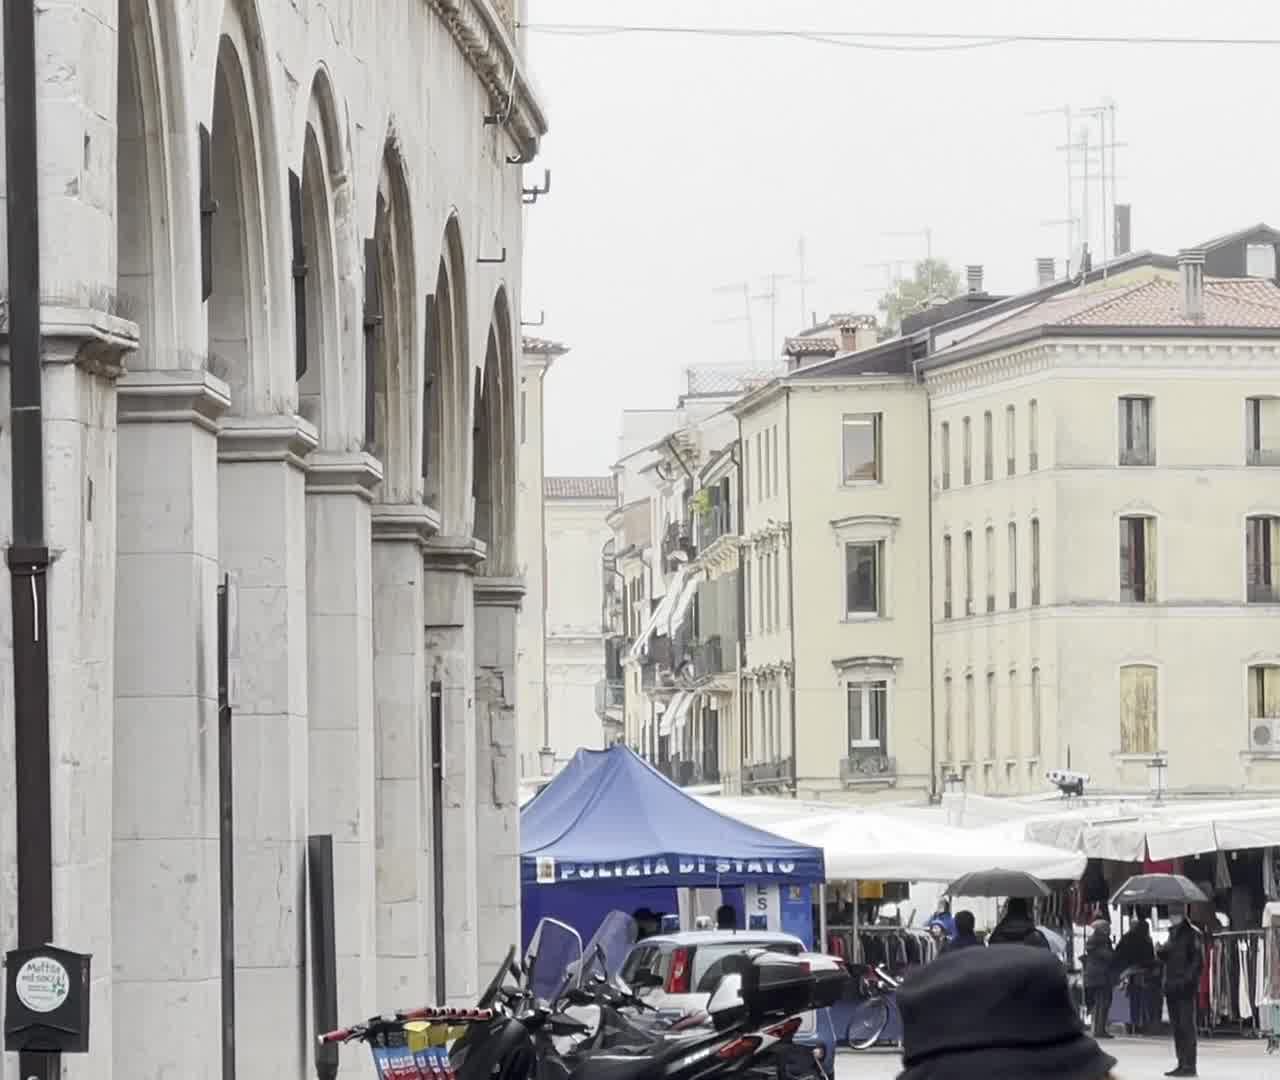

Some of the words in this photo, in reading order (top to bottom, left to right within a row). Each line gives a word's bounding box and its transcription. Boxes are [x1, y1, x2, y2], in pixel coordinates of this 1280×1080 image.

[560, 858, 670, 880] POLIZIA
[679, 857, 705, 874] DI
[715, 859, 796, 874] STATO
